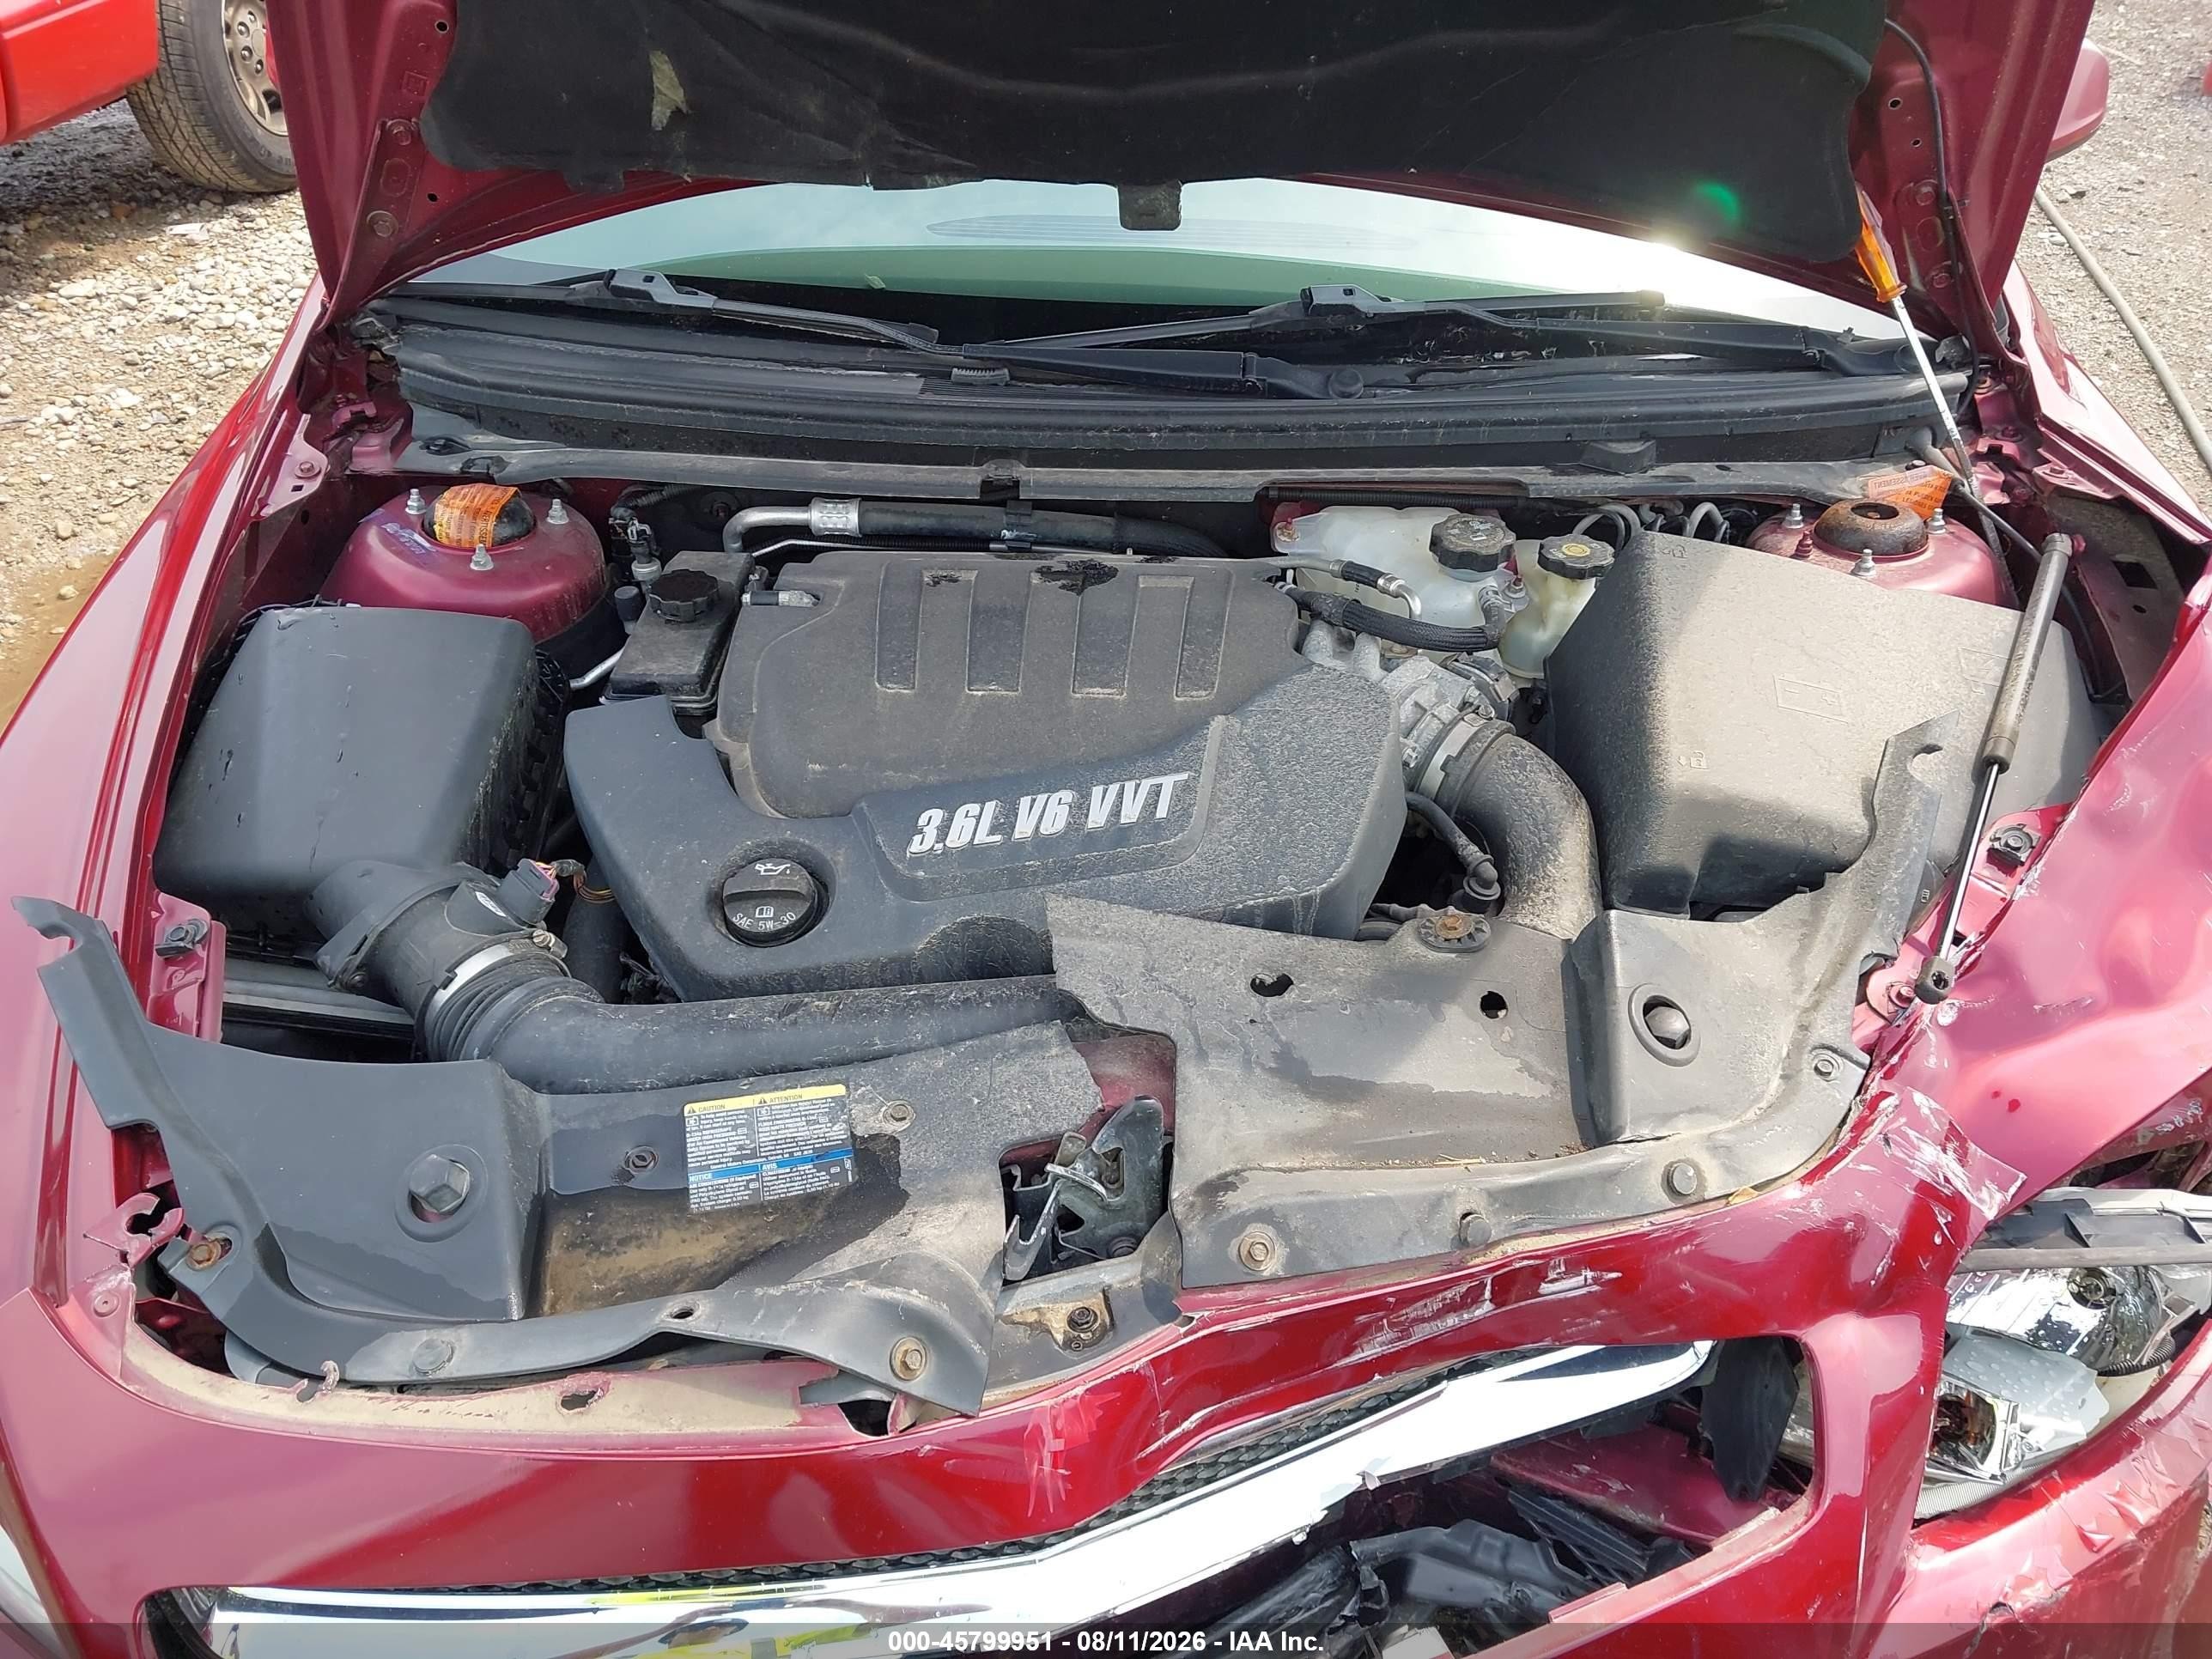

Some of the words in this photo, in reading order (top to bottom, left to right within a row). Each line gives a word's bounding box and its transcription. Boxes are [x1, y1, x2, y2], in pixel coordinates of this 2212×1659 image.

[908, 801, 1002, 855] 3.6L
[1013, 790, 1075, 839] V6
[1087, 773, 1190, 830] VVT
[733, 913, 754, 929] SAE
[758, 912, 796, 930] 5W-30
[769, 1093, 802, 1103] ATTENTION
[698, 1103, 726, 1112] CAUTION
[762, 1162, 777, 1170] AVIS
[689, 1172, 712, 1182] NOTICE
